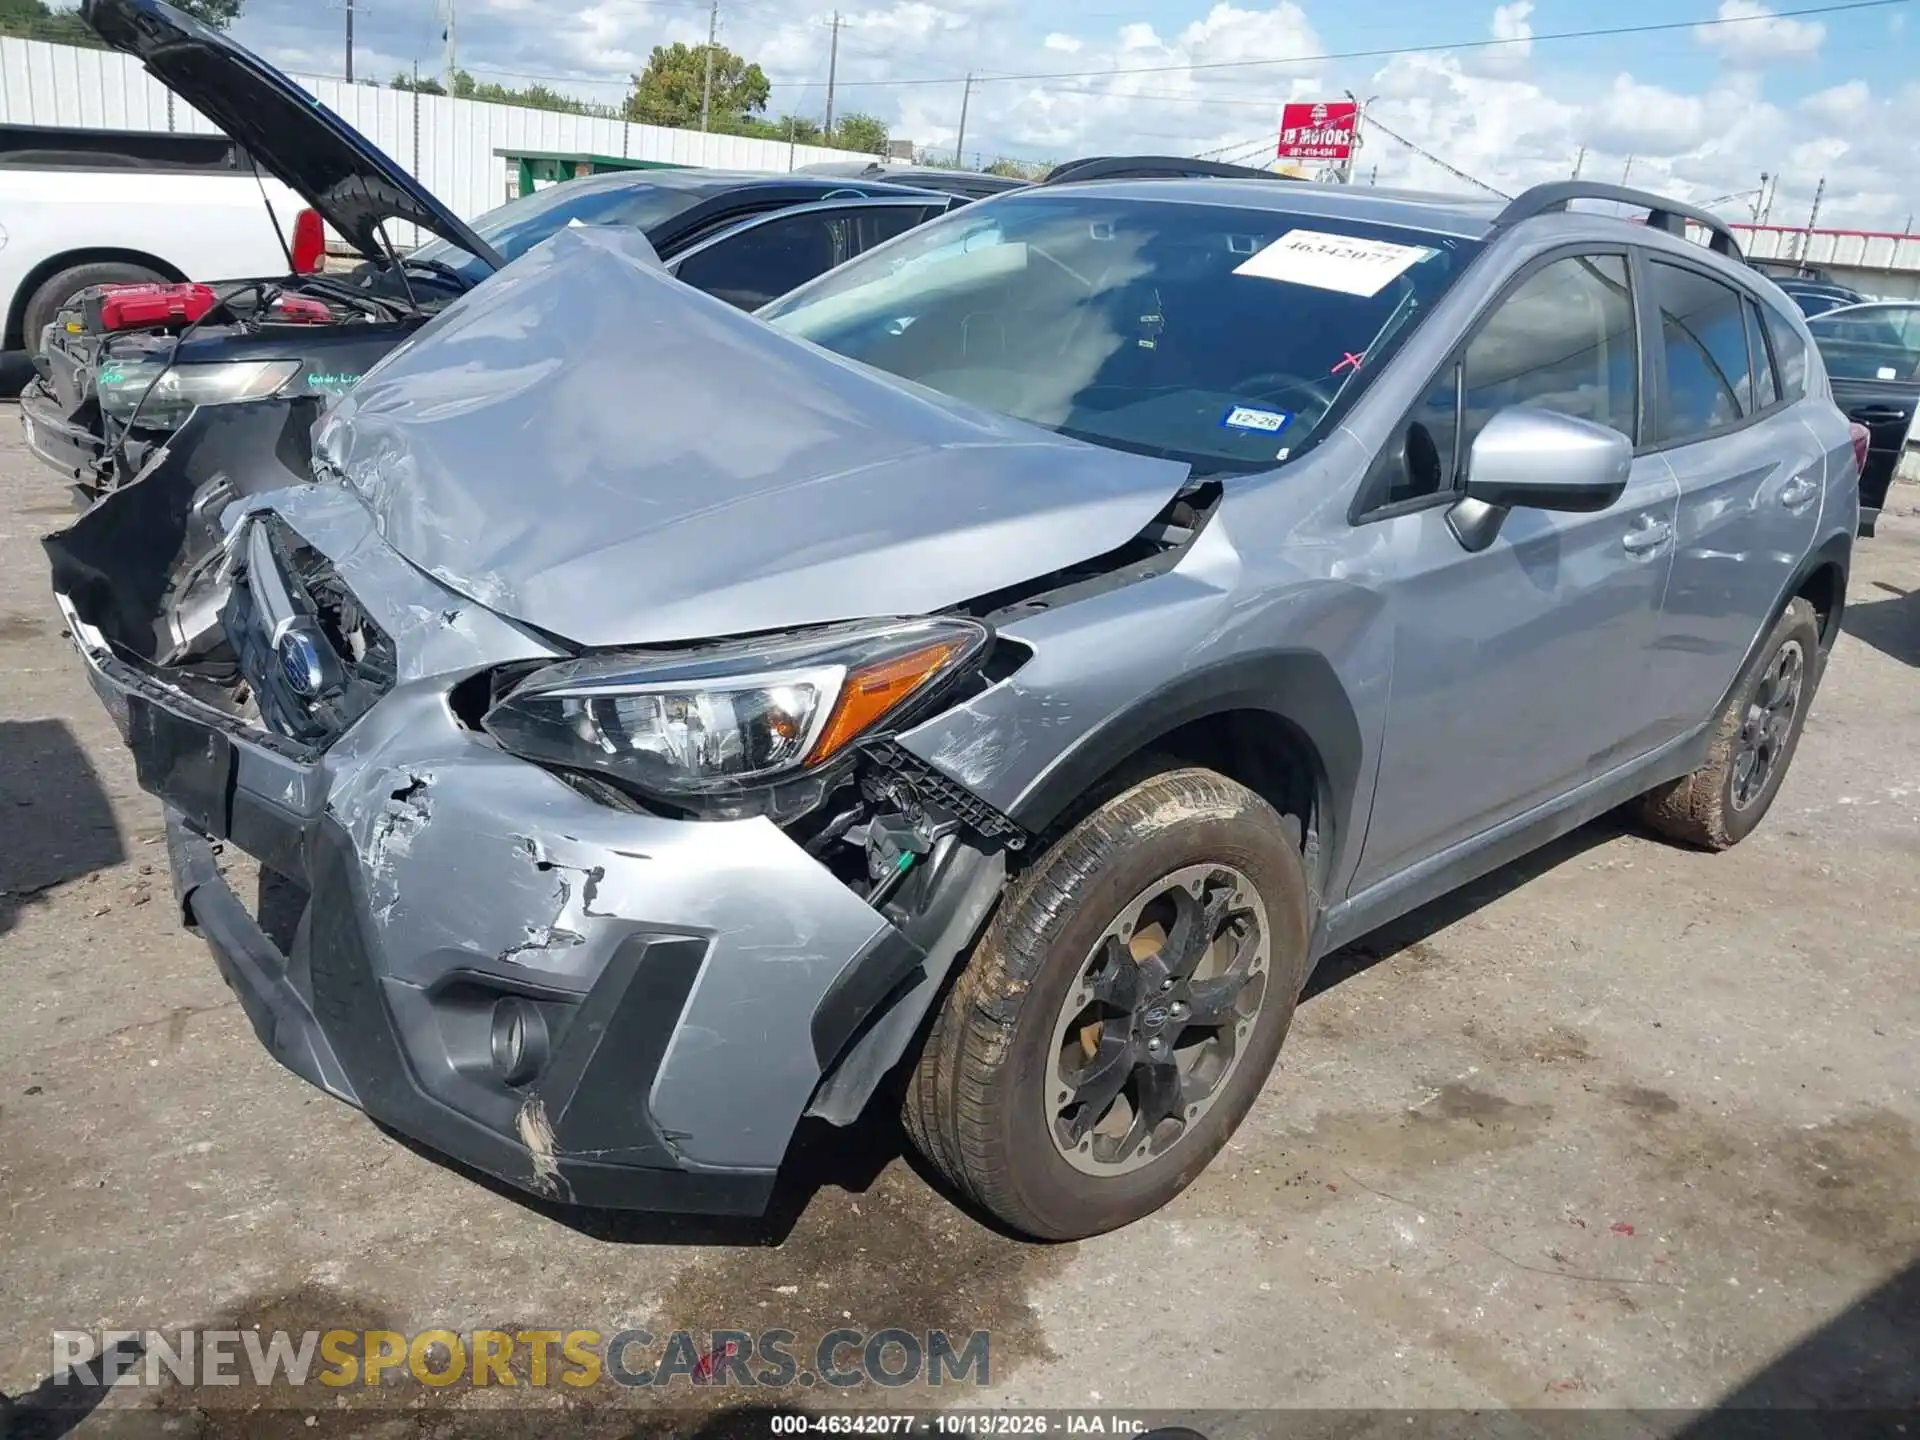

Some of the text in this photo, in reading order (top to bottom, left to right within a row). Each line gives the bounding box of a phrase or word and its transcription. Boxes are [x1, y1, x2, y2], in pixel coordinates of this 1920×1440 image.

[1299, 128, 1351, 146] MOTORS
[1285, 241, 1397, 264] 46342077
[1235, 413, 1279, 427] 12-26
